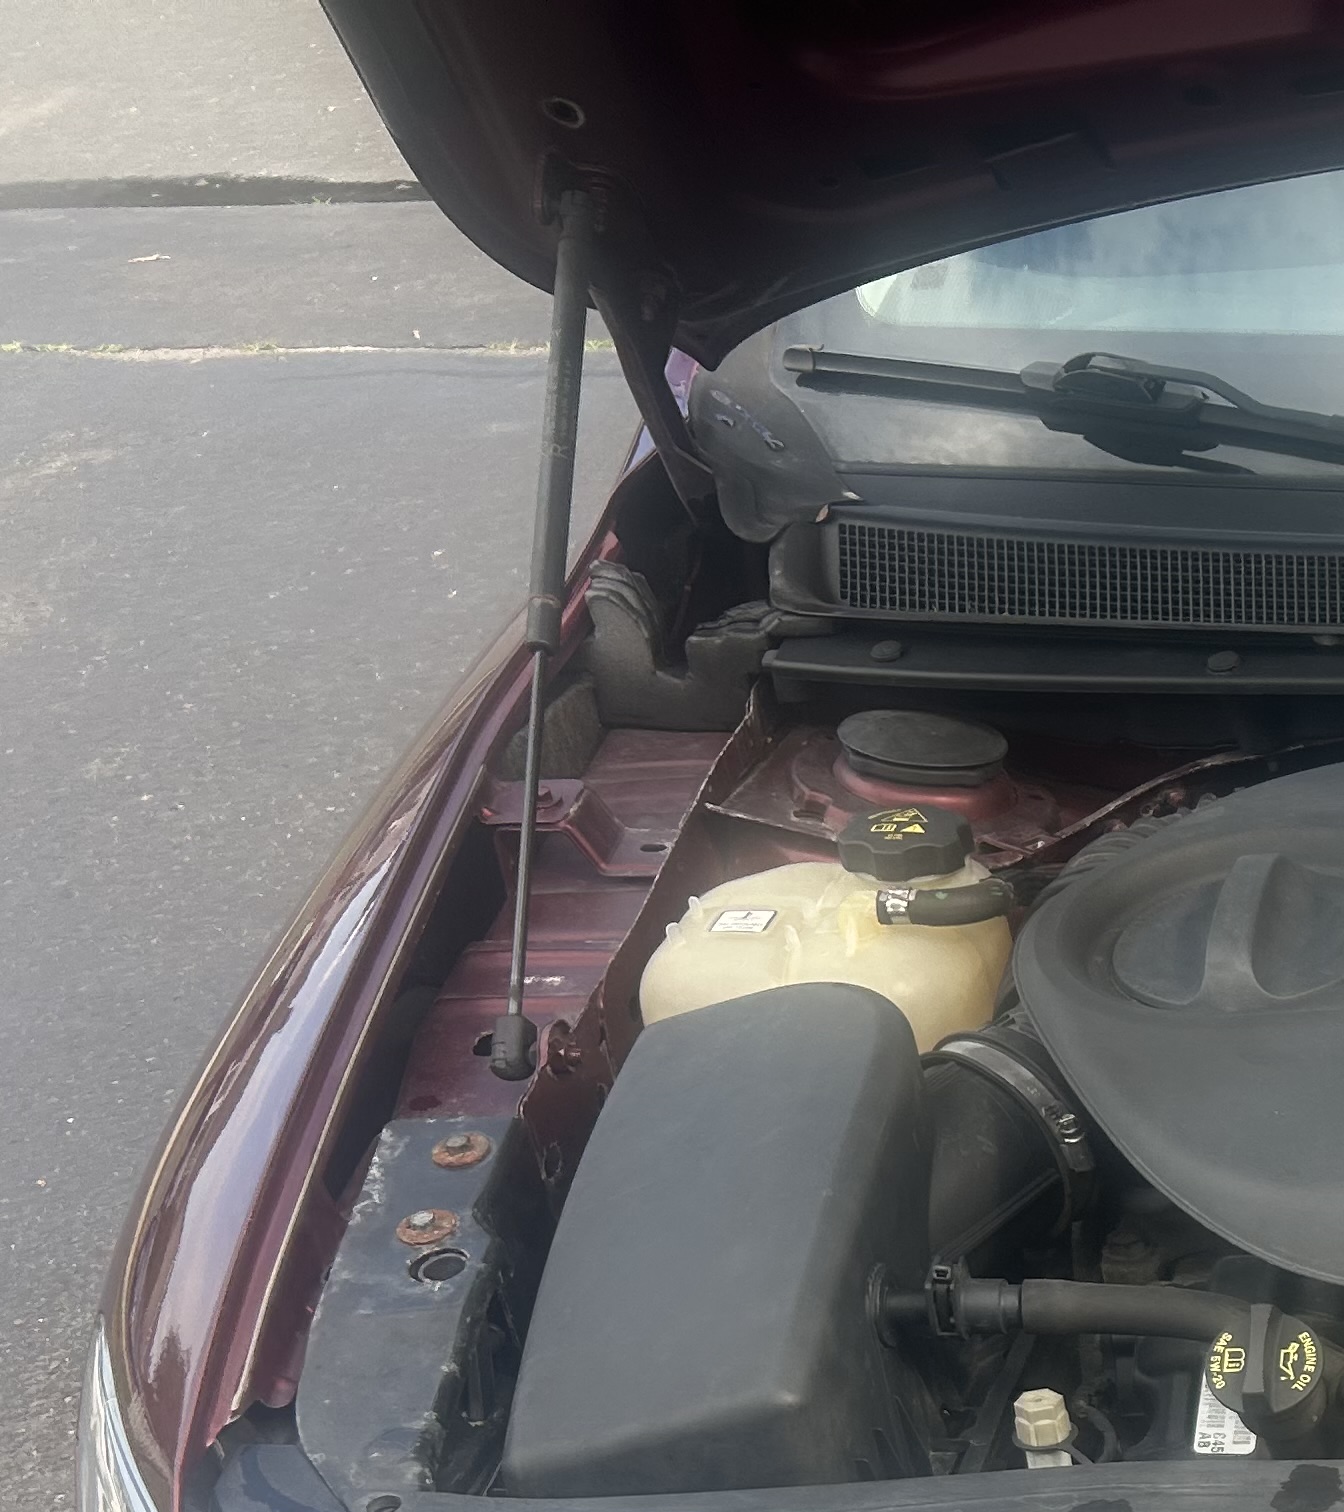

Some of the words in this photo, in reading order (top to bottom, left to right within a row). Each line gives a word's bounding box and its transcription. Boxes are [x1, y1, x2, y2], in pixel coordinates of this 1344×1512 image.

[1213, 1332, 1233, 1354] SAE
[1297, 1331, 1318, 1373] ENGINE
[1290, 1373, 1312, 1392] OIL
